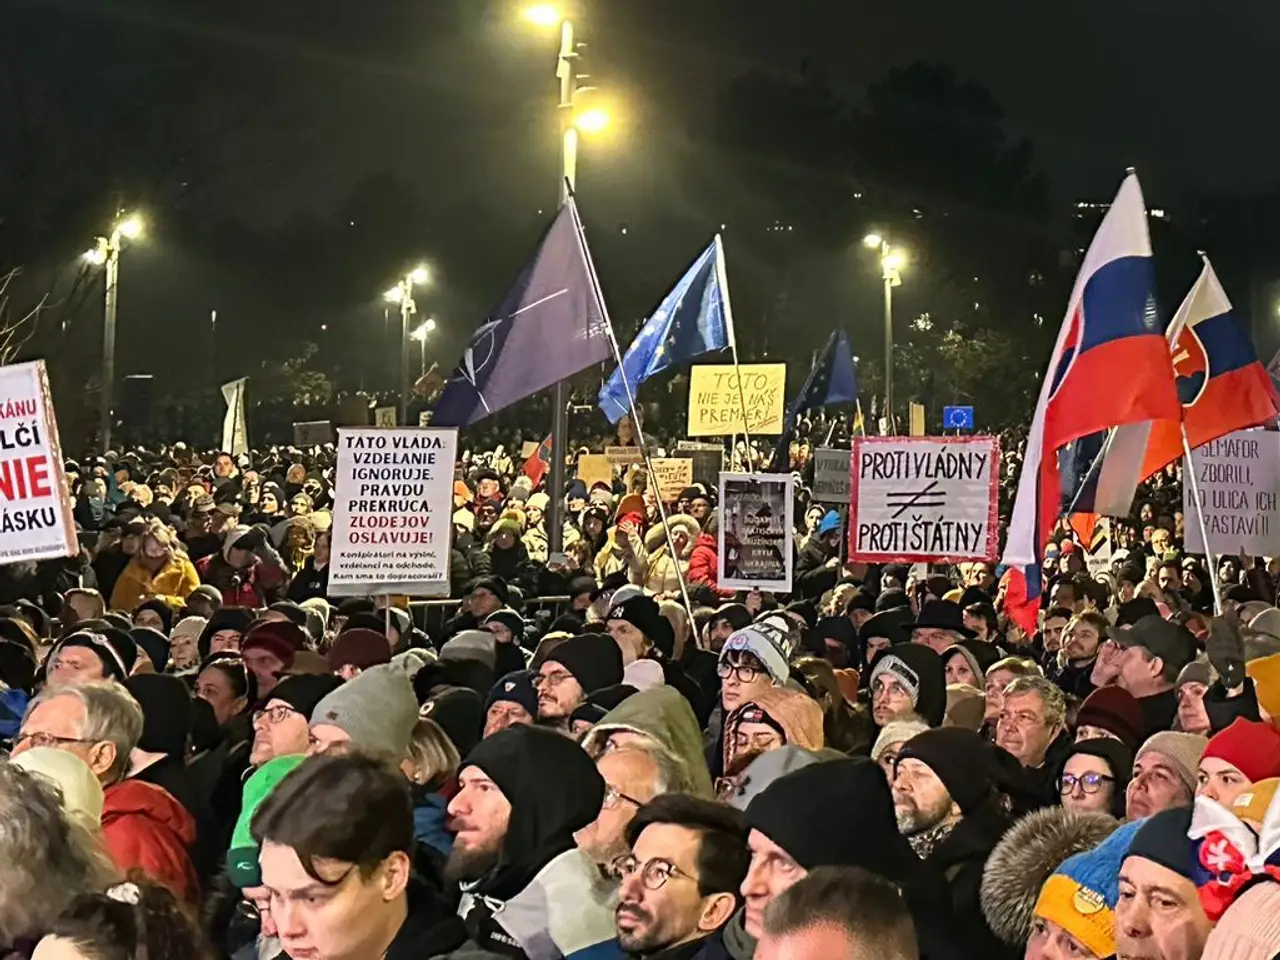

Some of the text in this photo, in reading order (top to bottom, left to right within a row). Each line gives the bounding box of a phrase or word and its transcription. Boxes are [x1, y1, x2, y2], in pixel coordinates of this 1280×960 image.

[713, 372, 768, 390] TOTO
[697, 387, 777, 406] NIE JE NÁŠ
[345, 433, 387, 449] TÁTO
[353, 452, 436, 465] VZDELANIE
[861, 446, 987, 480] PROTIVLÁDNY
[352, 467, 434, 480] IGNORUJE.
[1201, 462, 1254, 486] ZBORILI,
[360, 483, 424, 496] PRAVDU
[348, 497, 433, 512] PREKRÚCA.
[1212, 489, 1249, 509] ULICA
[1256, 491, 1277, 511] ICH
[0, 507, 57, 533] ÁSKU
[350, 515, 430, 528] ZLODEJOV
[349, 531, 433, 544] OSLAVUJE!
[858, 515, 983, 553] PROTIŠTÁTNY
